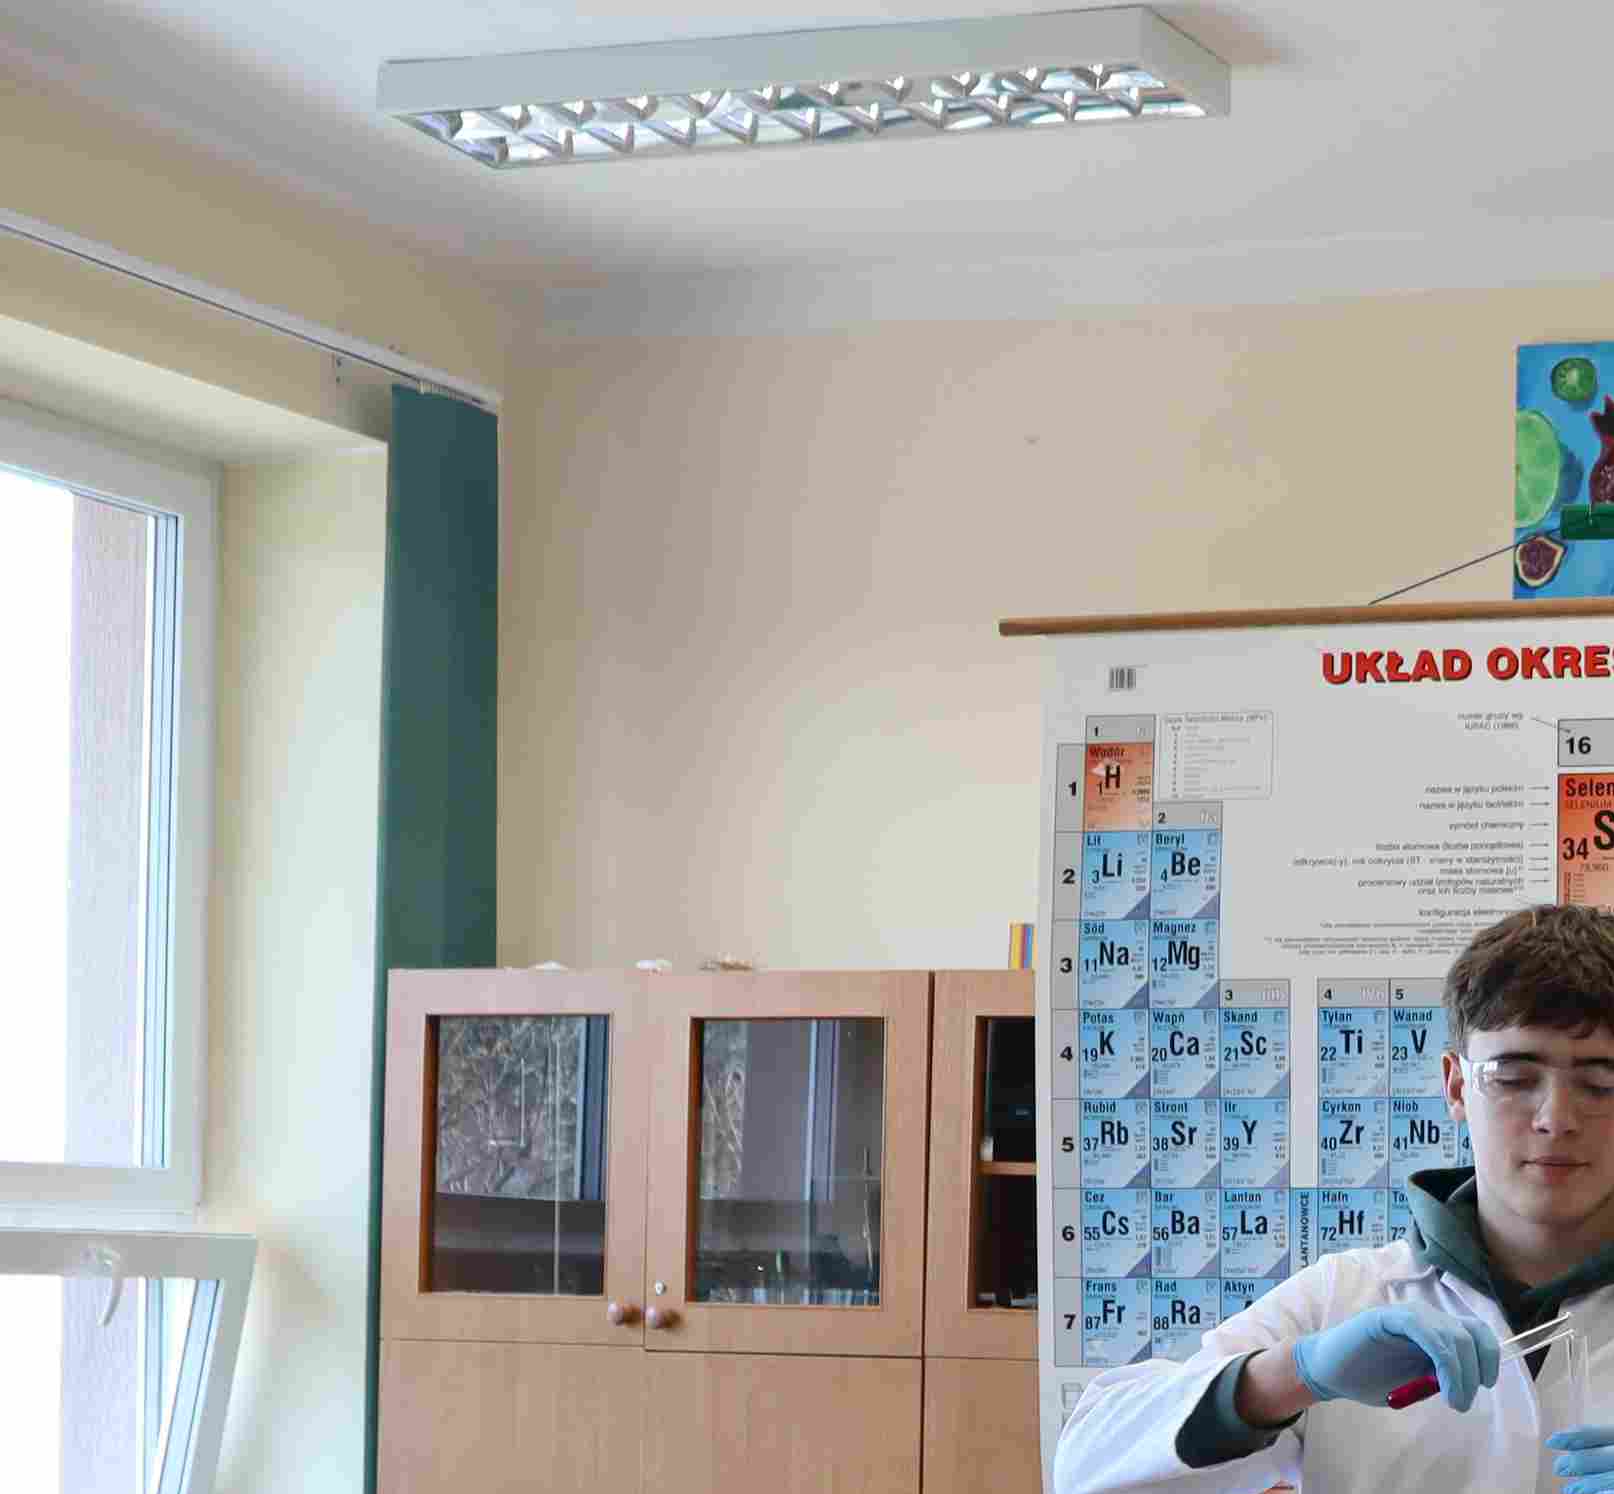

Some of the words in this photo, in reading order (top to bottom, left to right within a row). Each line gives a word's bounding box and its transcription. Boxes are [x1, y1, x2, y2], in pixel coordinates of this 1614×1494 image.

[1323, 649, 1472, 685] UKŁAD
[1094, 726, 1099, 737] 1
[1566, 736, 1591, 754] 16
[1068, 781, 1077, 796] 1
[1105, 765, 1120, 789] H
[1158, 812, 1166, 824] 2
[1562, 837, 1589, 861] 34
[1102, 853, 1122, 877] Li
[1171, 851, 1200, 876] Be
[1062, 868, 1075, 884] 2
[1060, 957, 1072, 973] 3
[1099, 941, 1129, 966] Na
[1168, 940, 1200, 970] Mg
[1225, 989, 1233, 1001] 3
[1324, 989, 1332, 1000] 4
[1395, 988, 1404, 1000] 5
[1060, 1046, 1073, 1061] 4
[1100, 1030, 1114, 1056] K
[1169, 1030, 1199, 1056] Ca
[1240, 1030, 1267, 1056] Sc
[1339, 1029, 1363, 1054] Ti
[1411, 1029, 1427, 1054] V
[1082, 1048, 1098, 1062] 19
[1101, 1120, 1128, 1145] Rb
[1153, 1136, 1168, 1151] 38
[1171, 1120, 1197, 1146] Sr
[1242, 1120, 1258, 1145] Y
[1339, 1120, 1365, 1144] Zr
[1410, 1119, 1440, 1144] Nb
[1062, 1137, 1074, 1153] 5
[1062, 1225, 1075, 1242] 6
[1084, 1226, 1100, 1241] 55
[1102, 1210, 1129, 1236] Cs
[1171, 1210, 1200, 1235] Ba
[1240, 1210, 1268, 1235] La
[1339, 1210, 1364, 1235] Hf
[1064, 1314, 1076, 1330] 7
[1102, 1299, 1126, 1324] Fr
[1171, 1299, 1200, 1324] Ra
